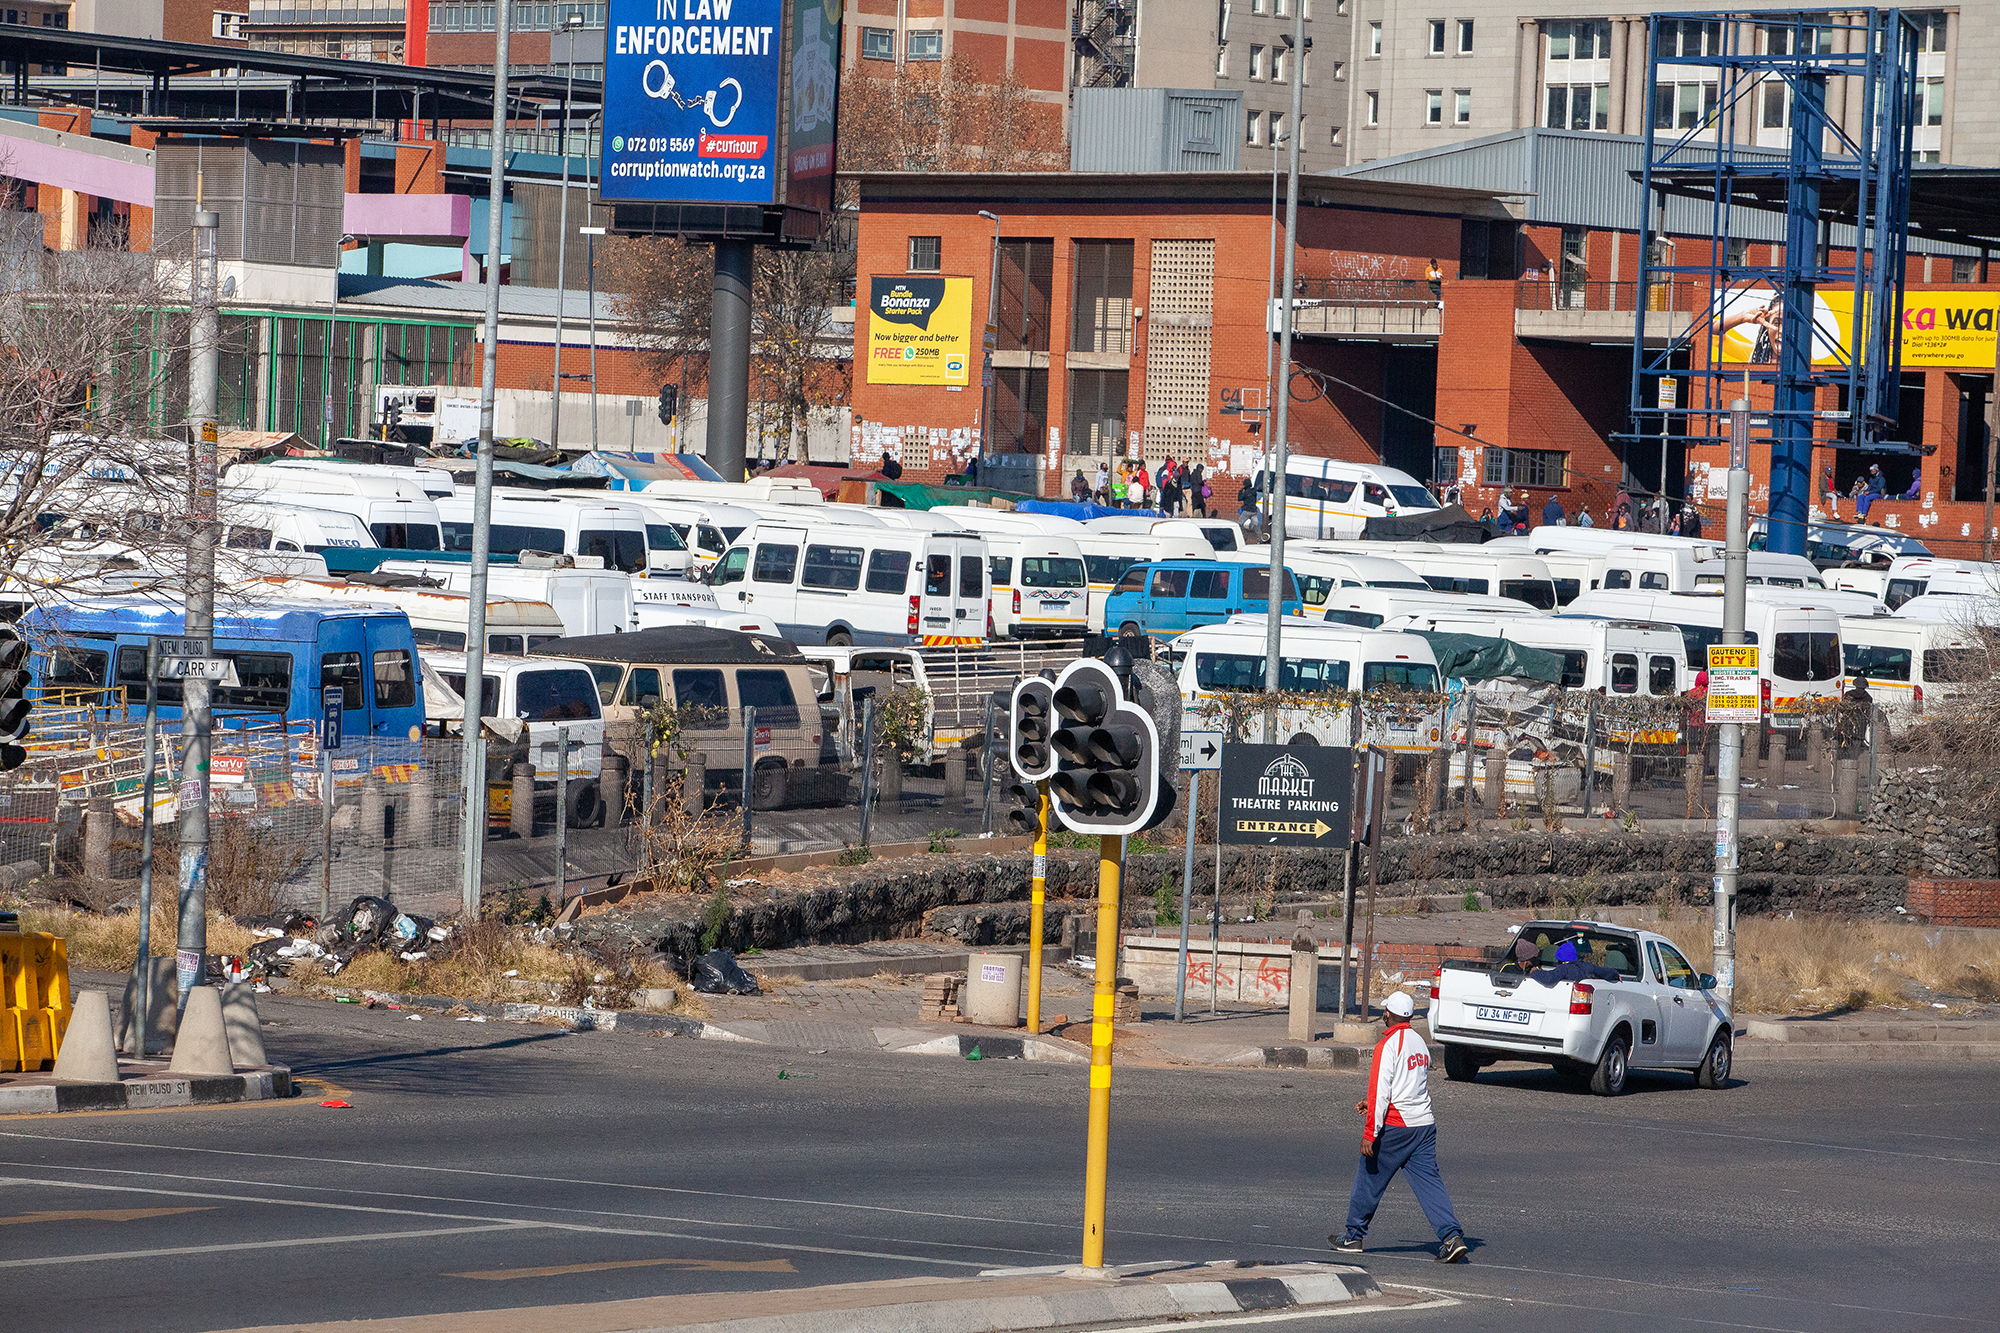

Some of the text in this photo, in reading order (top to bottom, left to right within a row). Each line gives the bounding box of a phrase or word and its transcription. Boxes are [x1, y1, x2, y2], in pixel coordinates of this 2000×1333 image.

[656, 0, 732, 20] IN LAW
[615, 26, 773, 55] ENFORCEMENT
[627, 138, 695, 152] 072 013 5569
[706, 140, 758, 154] #CUTitOUT
[611, 159, 766, 182] corruptionwatch.org.za
[890, 290, 913, 298] Bundle
[881, 295, 930, 307] Bonanza
[885, 307, 907, 315] Starter
[874, 333, 891, 341] Now
[893, 333, 918, 343] bigger
[935, 334, 959, 342] better
[915, 348, 940, 356] 250MB
[1221, 388, 1241, 403] C4
[326, 538, 360, 547] IVECO
[643, 592, 714, 602] STAFF TRANSPORT
[184, 640, 204, 655] PILISO
[1712, 656, 1746, 665] CITY
[178, 661, 219, 676] CARR ST
[327, 721, 337, 746] R
[210, 758, 243, 768] learVu
[1280, 765, 1294, 777] THE
[1258, 776, 1315, 797] MARKET
[1232, 798, 1339, 812] THEATRE PARKING
[1238, 821, 1315, 832] ENTRANCE
[1479, 1008, 1528, 1021] CV 34 NF GP
[177, 1082, 186, 1093] ST
